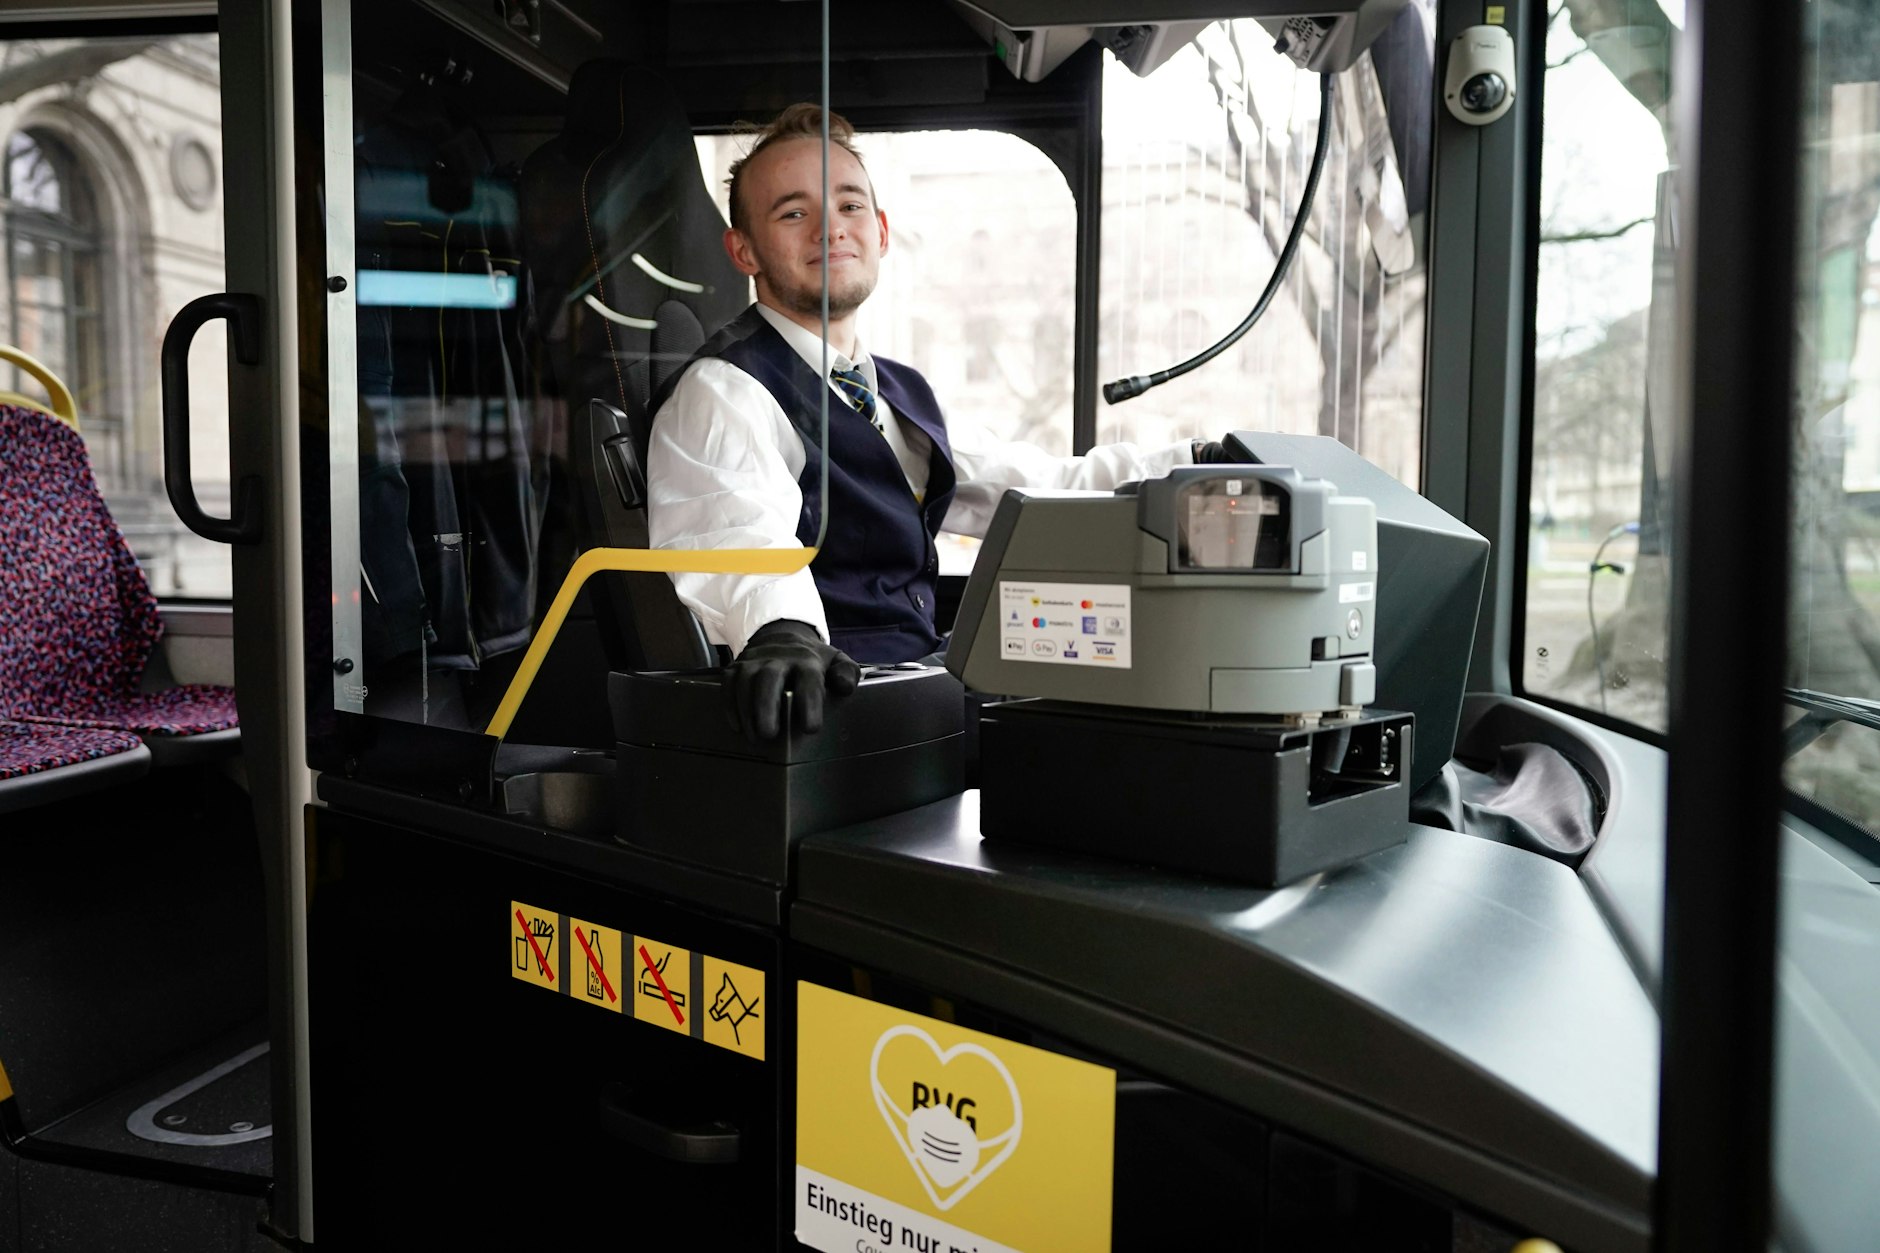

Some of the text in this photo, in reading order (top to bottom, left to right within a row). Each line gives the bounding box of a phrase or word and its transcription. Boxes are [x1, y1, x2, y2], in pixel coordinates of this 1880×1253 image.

[1096, 647, 1114, 655] VISA
[590, 985, 600, 995] Alc
[807, 1182, 893, 1246] Einstieg
